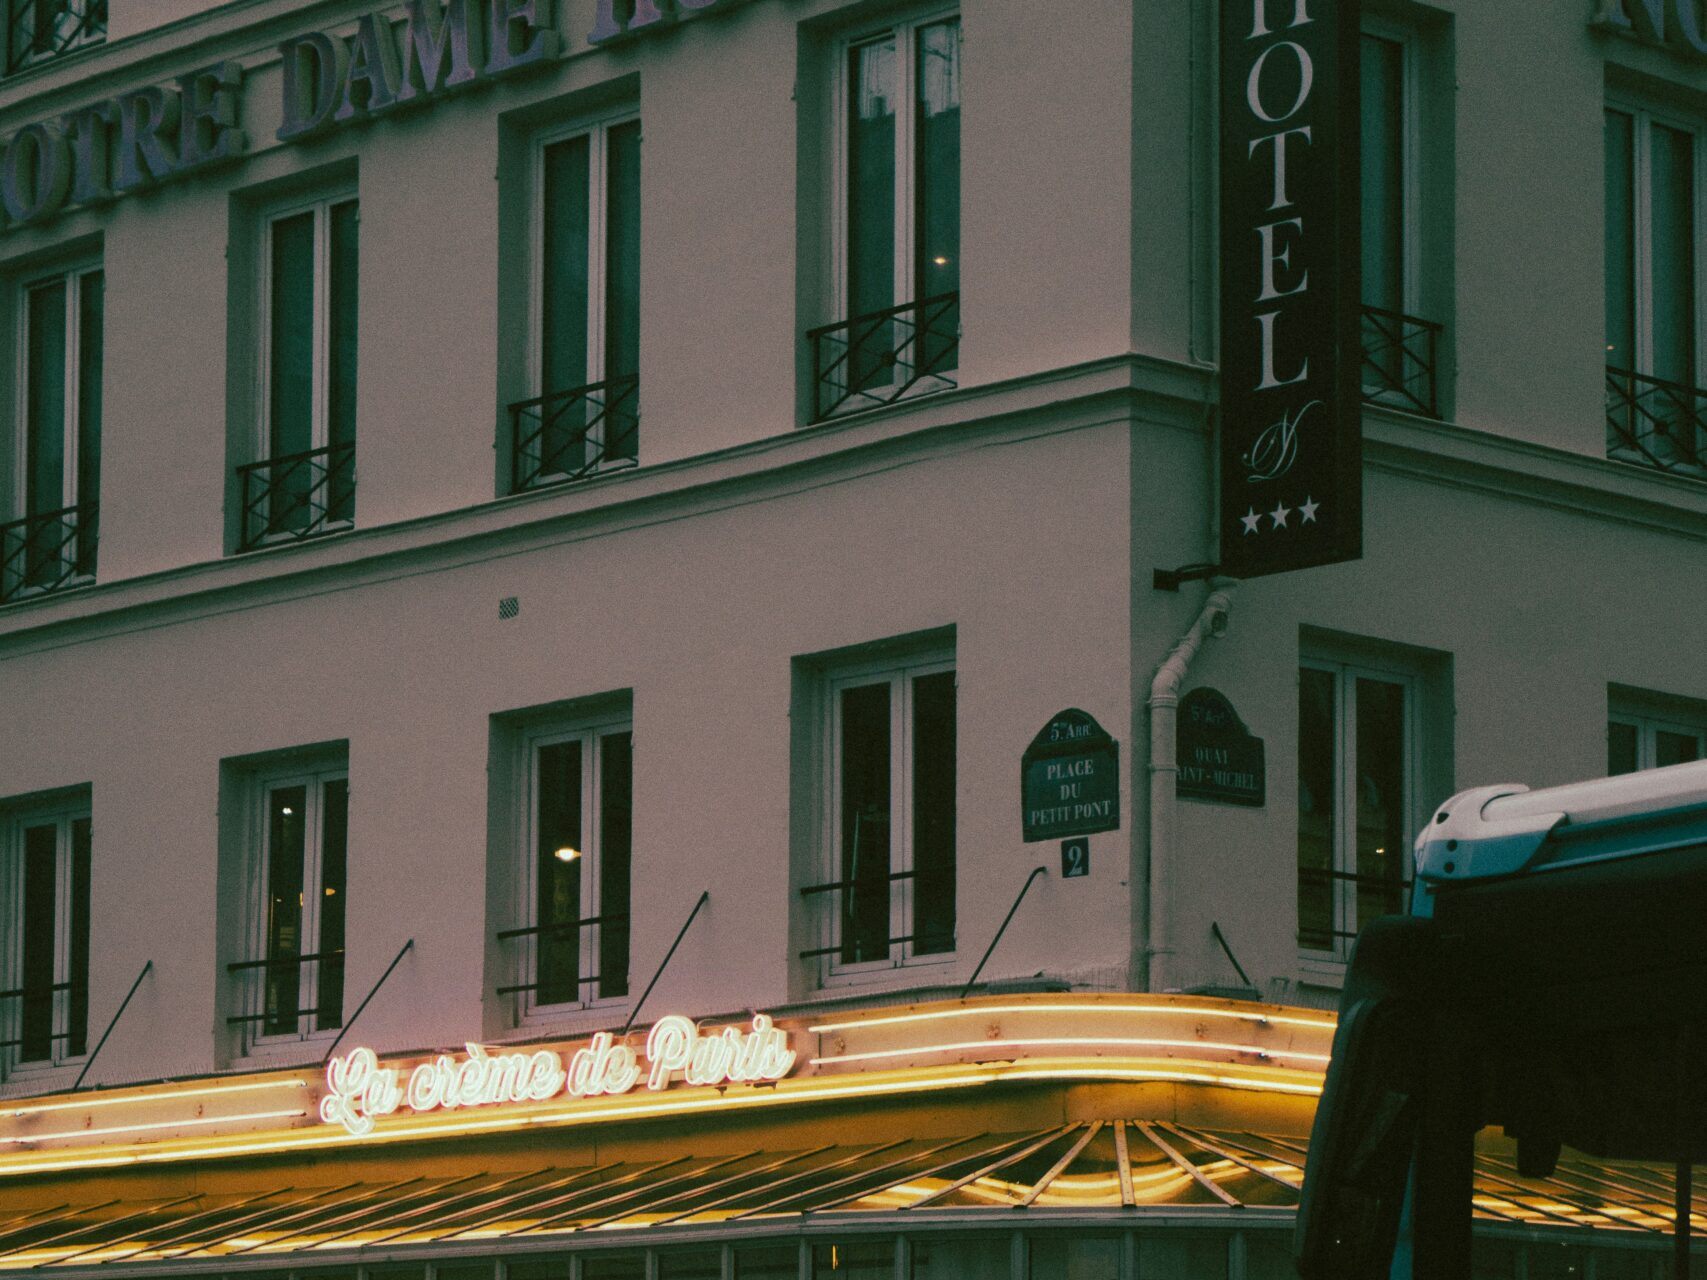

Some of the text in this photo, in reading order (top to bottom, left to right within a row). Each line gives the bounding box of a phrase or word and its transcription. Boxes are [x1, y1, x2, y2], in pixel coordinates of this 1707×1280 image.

[1047, 759, 1094, 781] PLACE
[1060, 783, 1080, 799] DU
[1031, 800, 1111, 826] PETIT PONT
[1068, 846, 1082, 876] 2
[321, 1013, 797, 1134] La crème de Paris
